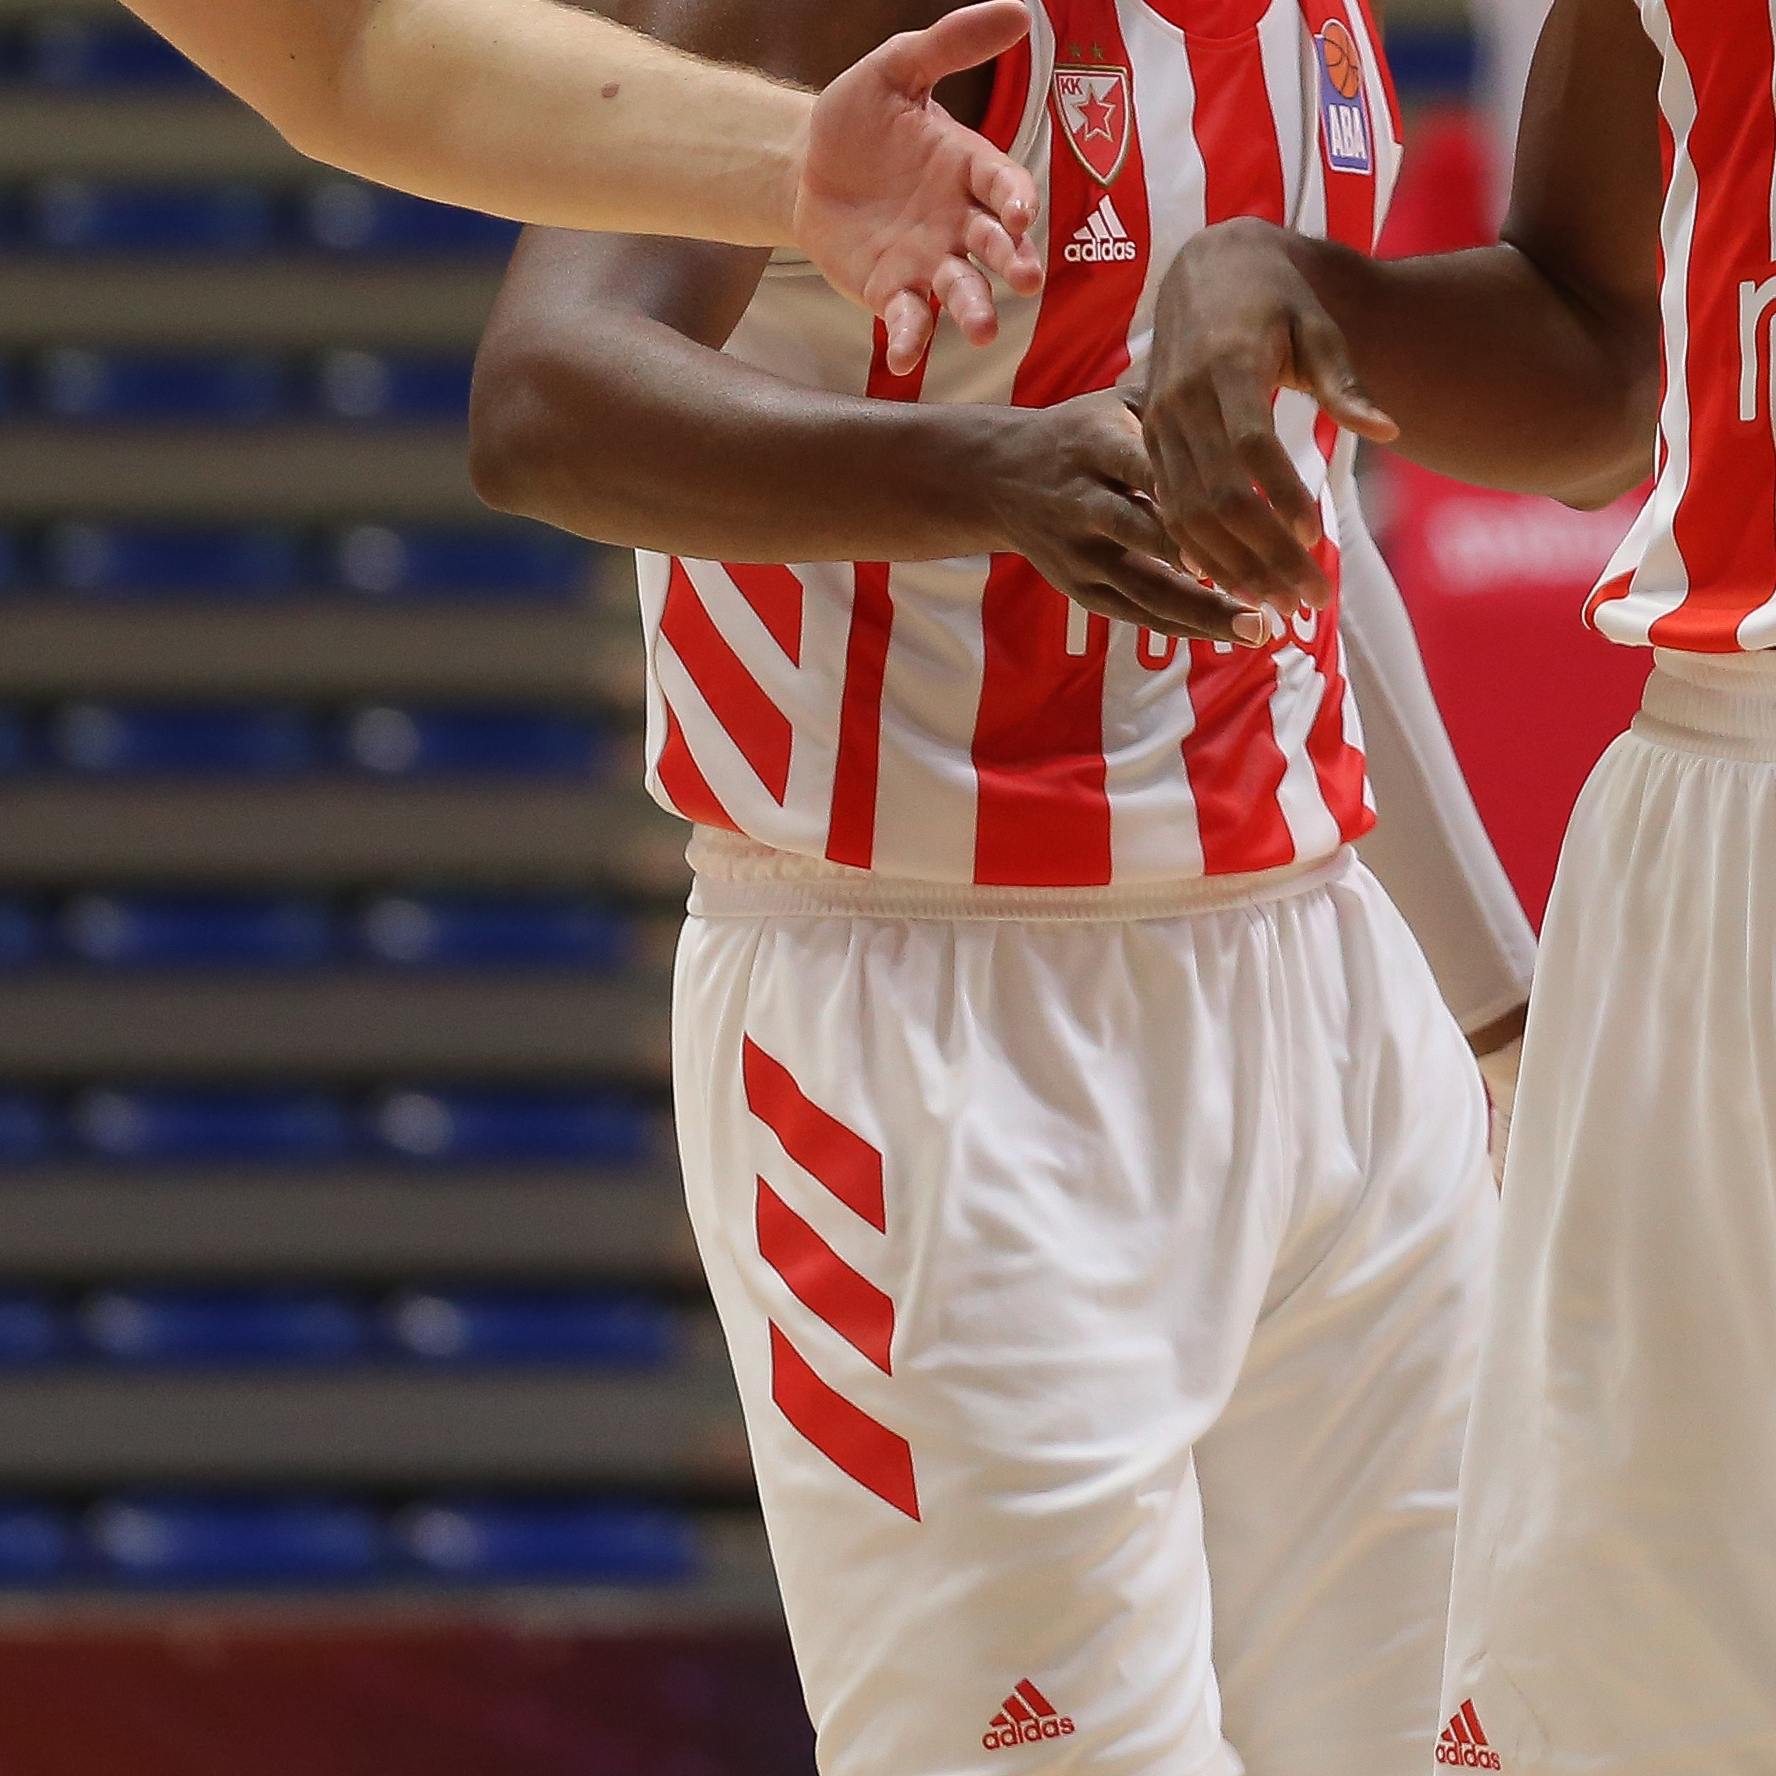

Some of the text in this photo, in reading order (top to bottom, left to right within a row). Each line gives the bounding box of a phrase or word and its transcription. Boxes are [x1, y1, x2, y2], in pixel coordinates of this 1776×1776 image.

[1060, 77, 1083, 95] KK
[1328, 104, 1368, 159] ABA
[1064, 236, 1137, 262] adidas
[982, 1717, 1075, 1750] adidas
[1435, 1741, 1501, 1771] adidas
